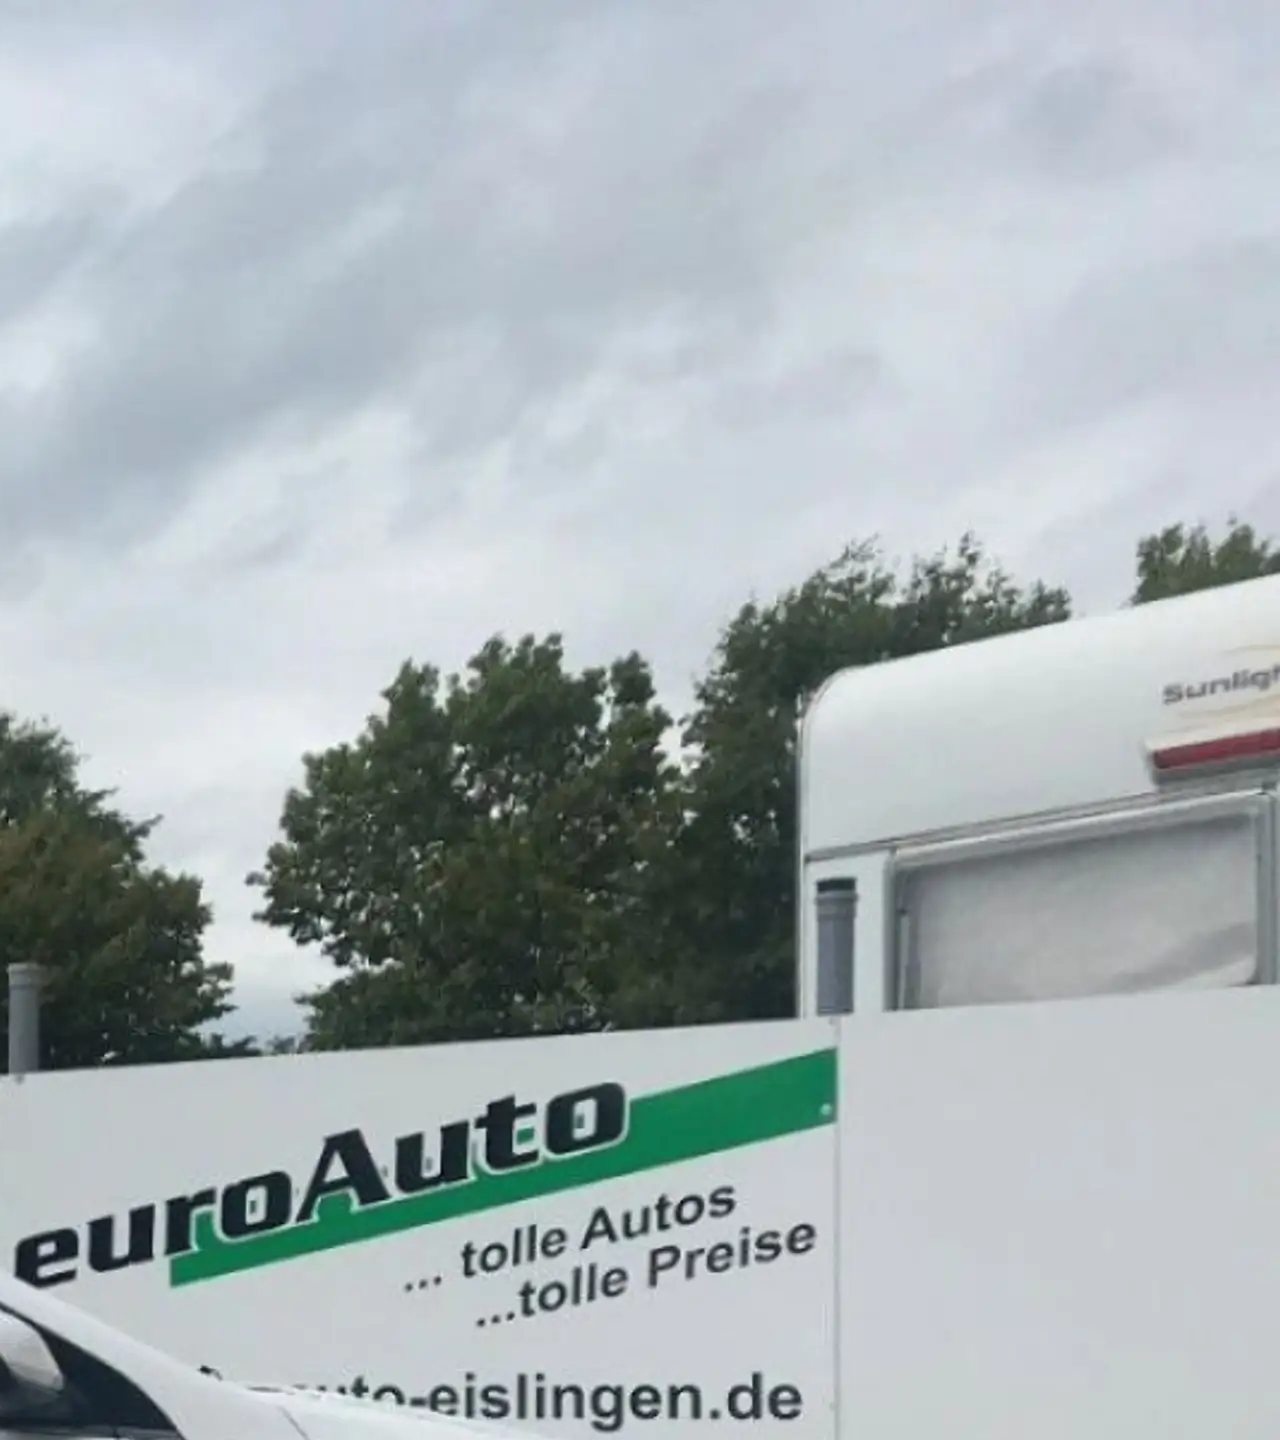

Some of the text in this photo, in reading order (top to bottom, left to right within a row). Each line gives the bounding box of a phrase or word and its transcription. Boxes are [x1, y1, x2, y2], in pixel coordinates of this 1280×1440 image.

[14, 1081, 627, 1289] euroAuto
[460, 1224, 568, 1278] tolle
[579, 1184, 738, 1250] Autos
[647, 1221, 818, 1290] Preise
